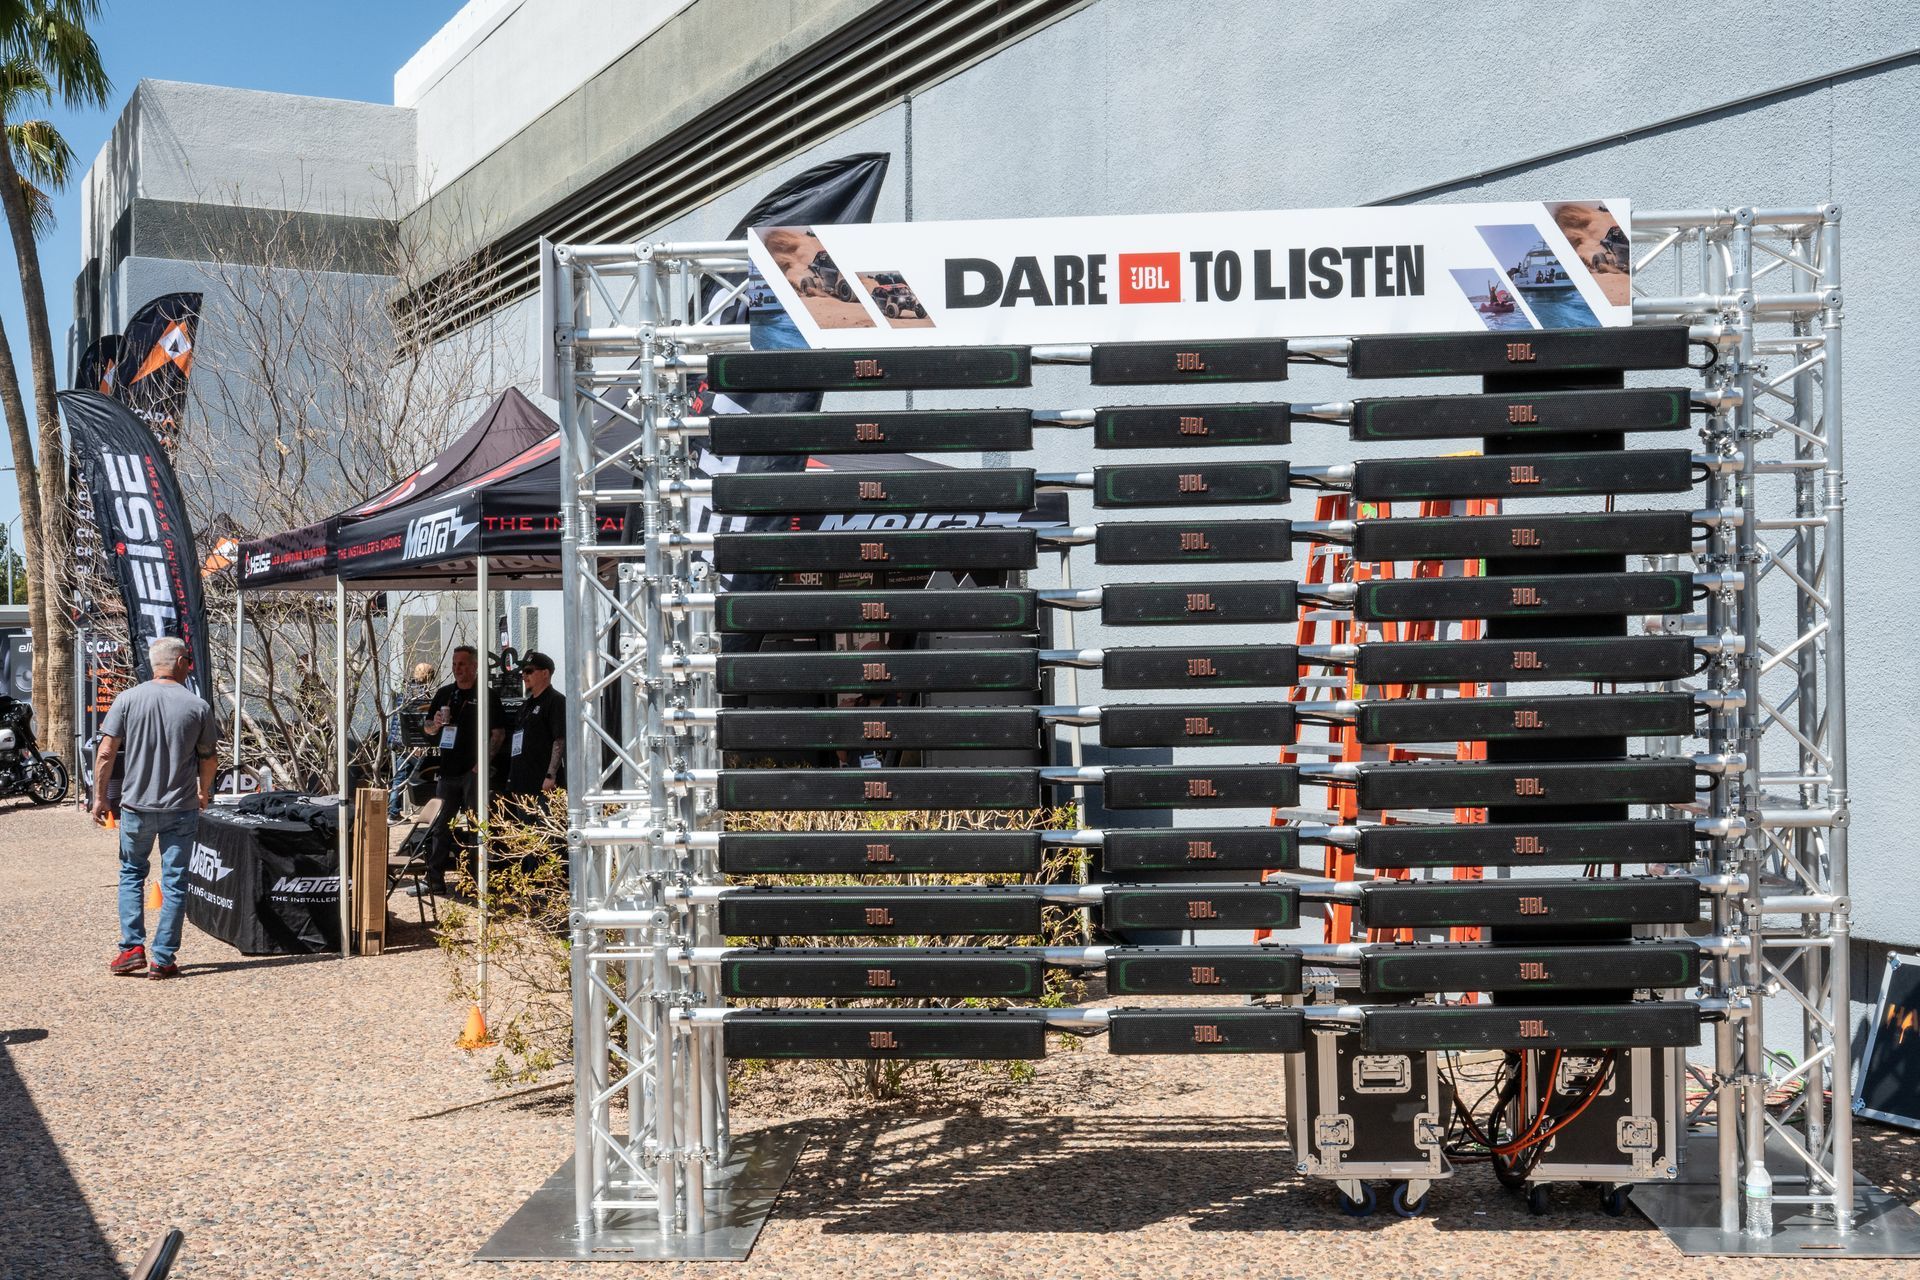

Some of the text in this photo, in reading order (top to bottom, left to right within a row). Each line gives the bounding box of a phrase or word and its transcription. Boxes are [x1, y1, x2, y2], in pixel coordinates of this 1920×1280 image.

[945, 245, 1425, 309] DARE JBL TO LISTEN
[1507, 344, 1535, 360] JBL
[854, 359, 882, 377] JBL
[1177, 353, 1204, 370] JBL
[1509, 405, 1536, 422] JBL
[857, 424, 884, 440] JBL
[1181, 417, 1207, 434] JBL
[1179, 474, 1206, 491] JBL
[1510, 466, 1539, 483] JBL
[144, 455, 170, 531] SYSTEMS
[859, 482, 885, 498] JBL
[483, 517, 533, 531] THE
[1181, 533, 1209, 549] JBL
[1512, 528, 1540, 545] JBL
[338, 548, 347, 559] THE
[348, 541, 380, 557] INSTALLER'S
[380, 535, 402, 551] CHOICE
[861, 544, 888, 559] JBL
[1187, 594, 1215, 610] JBL
[1512, 588, 1540, 604] JBL
[862, 603, 889, 619] JBL
[1188, 659, 1216, 675] JBL
[1514, 652, 1541, 668] JBL
[864, 664, 890, 680] JBL
[1185, 718, 1213, 734] JBL
[1515, 711, 1542, 727] JBL
[864, 721, 890, 738] JBL
[864, 782, 891, 798] JBL
[1189, 779, 1216, 796] JBL
[1515, 778, 1544, 795] JBL
[866, 844, 894, 861] JBL
[1188, 841, 1216, 858] JBL
[1515, 836, 1544, 853] JBL
[1189, 901, 1216, 918] JBL
[1520, 897, 1548, 914] JBL
[865, 908, 893, 924] JBL
[869, 970, 895, 986] JBL
[1192, 967, 1220, 983] JBL
[1520, 963, 1548, 979] JBL
[1194, 1025, 1222, 1042] JBL
[1520, 1020, 1548, 1037] JBL
[870, 1032, 896, 1048] JBL
